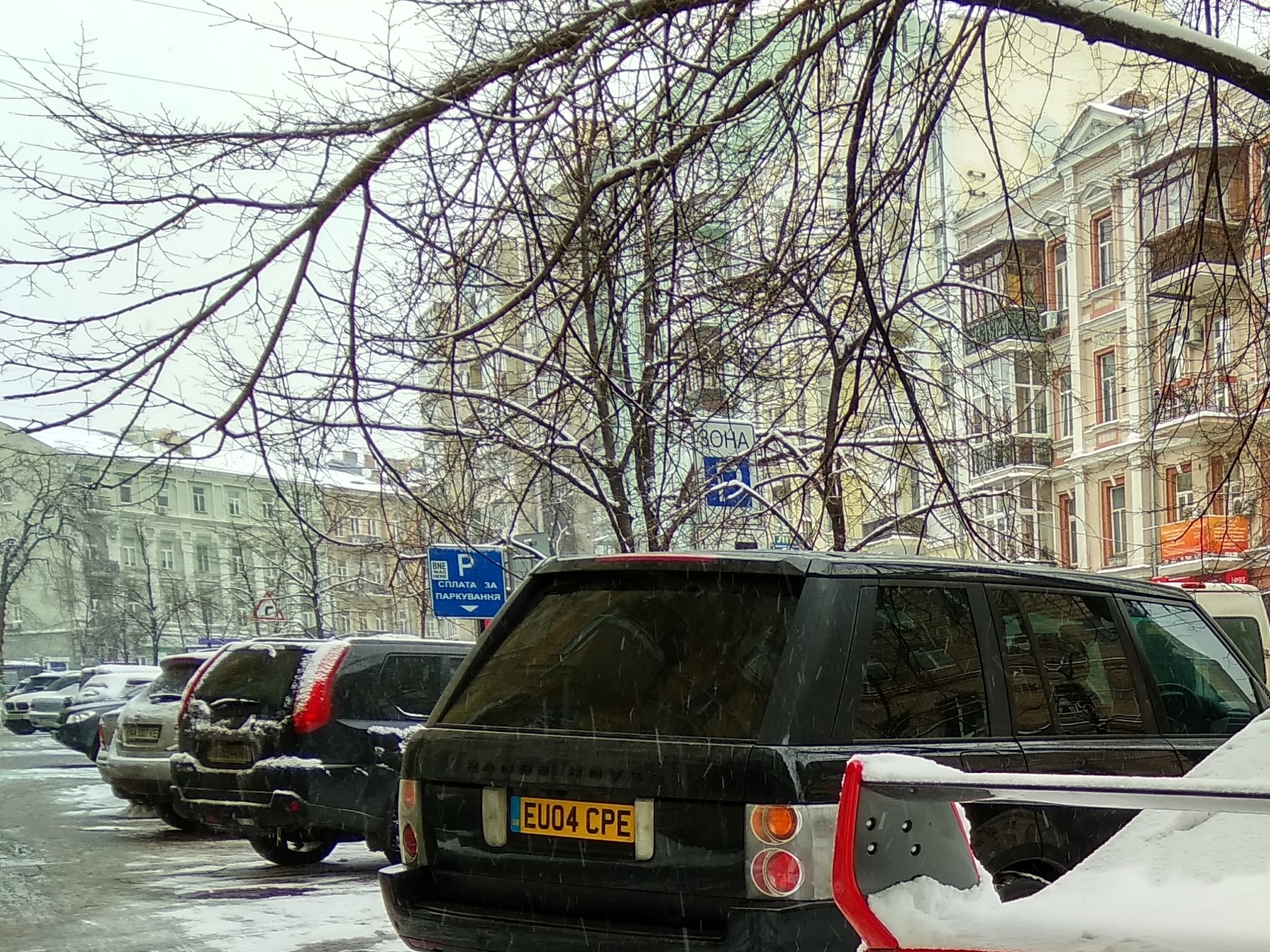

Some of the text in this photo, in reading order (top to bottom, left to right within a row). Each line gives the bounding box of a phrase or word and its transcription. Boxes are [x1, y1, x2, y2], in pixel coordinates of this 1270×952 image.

[699, 429, 749, 449] ЗОНА
[432, 561, 447, 570] BNE
[457, 553, 475, 577] P
[437, 580, 498, 589] СПЛАТА ЗА
[435, 592, 501, 601] ПАРКУВАННЯ
[523, 801, 631, 838] EU04 CPE
